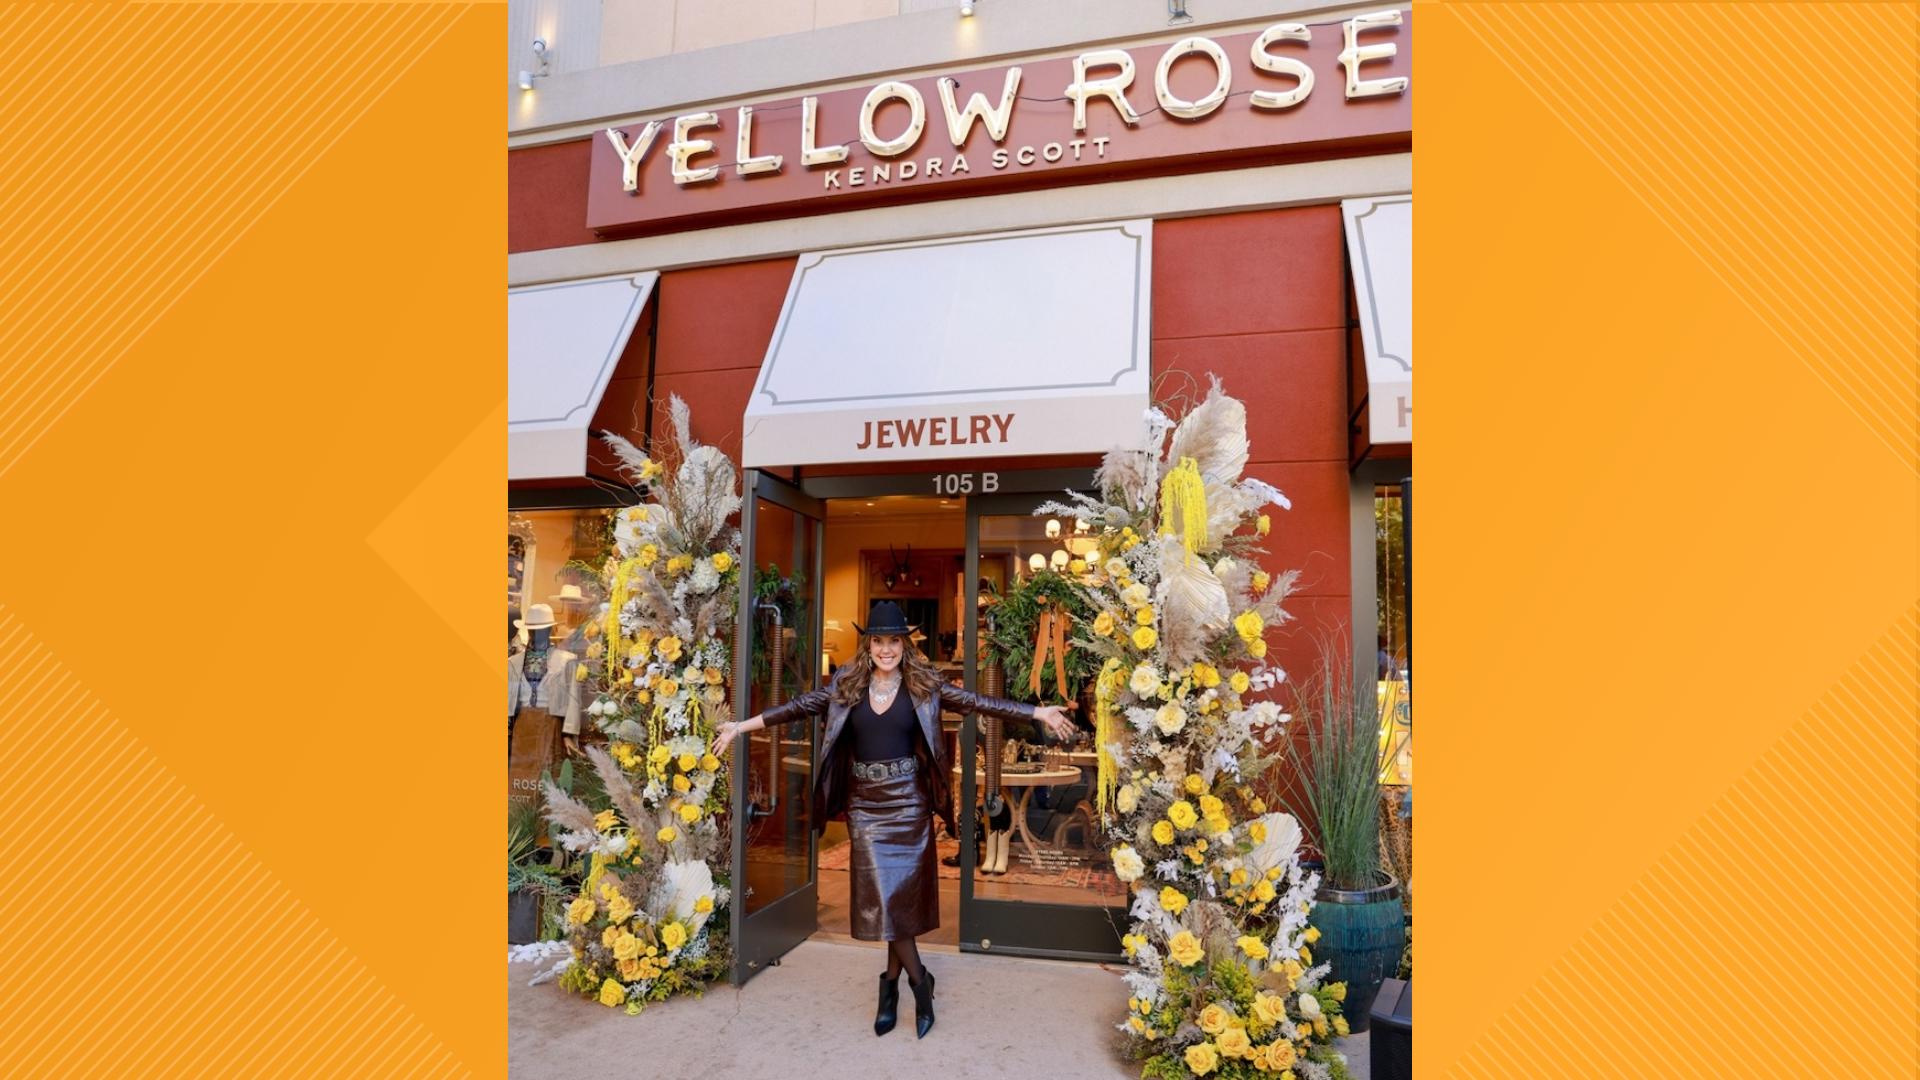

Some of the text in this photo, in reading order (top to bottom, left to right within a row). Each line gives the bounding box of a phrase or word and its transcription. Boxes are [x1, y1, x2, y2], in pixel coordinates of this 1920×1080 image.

[606, 9, 1409, 194] YELLOW ROSE
[824, 137, 1110, 190] KENDRA SCOTT
[856, 413, 1016, 450] JEWELRY
[932, 472, 999, 494] 105 B
